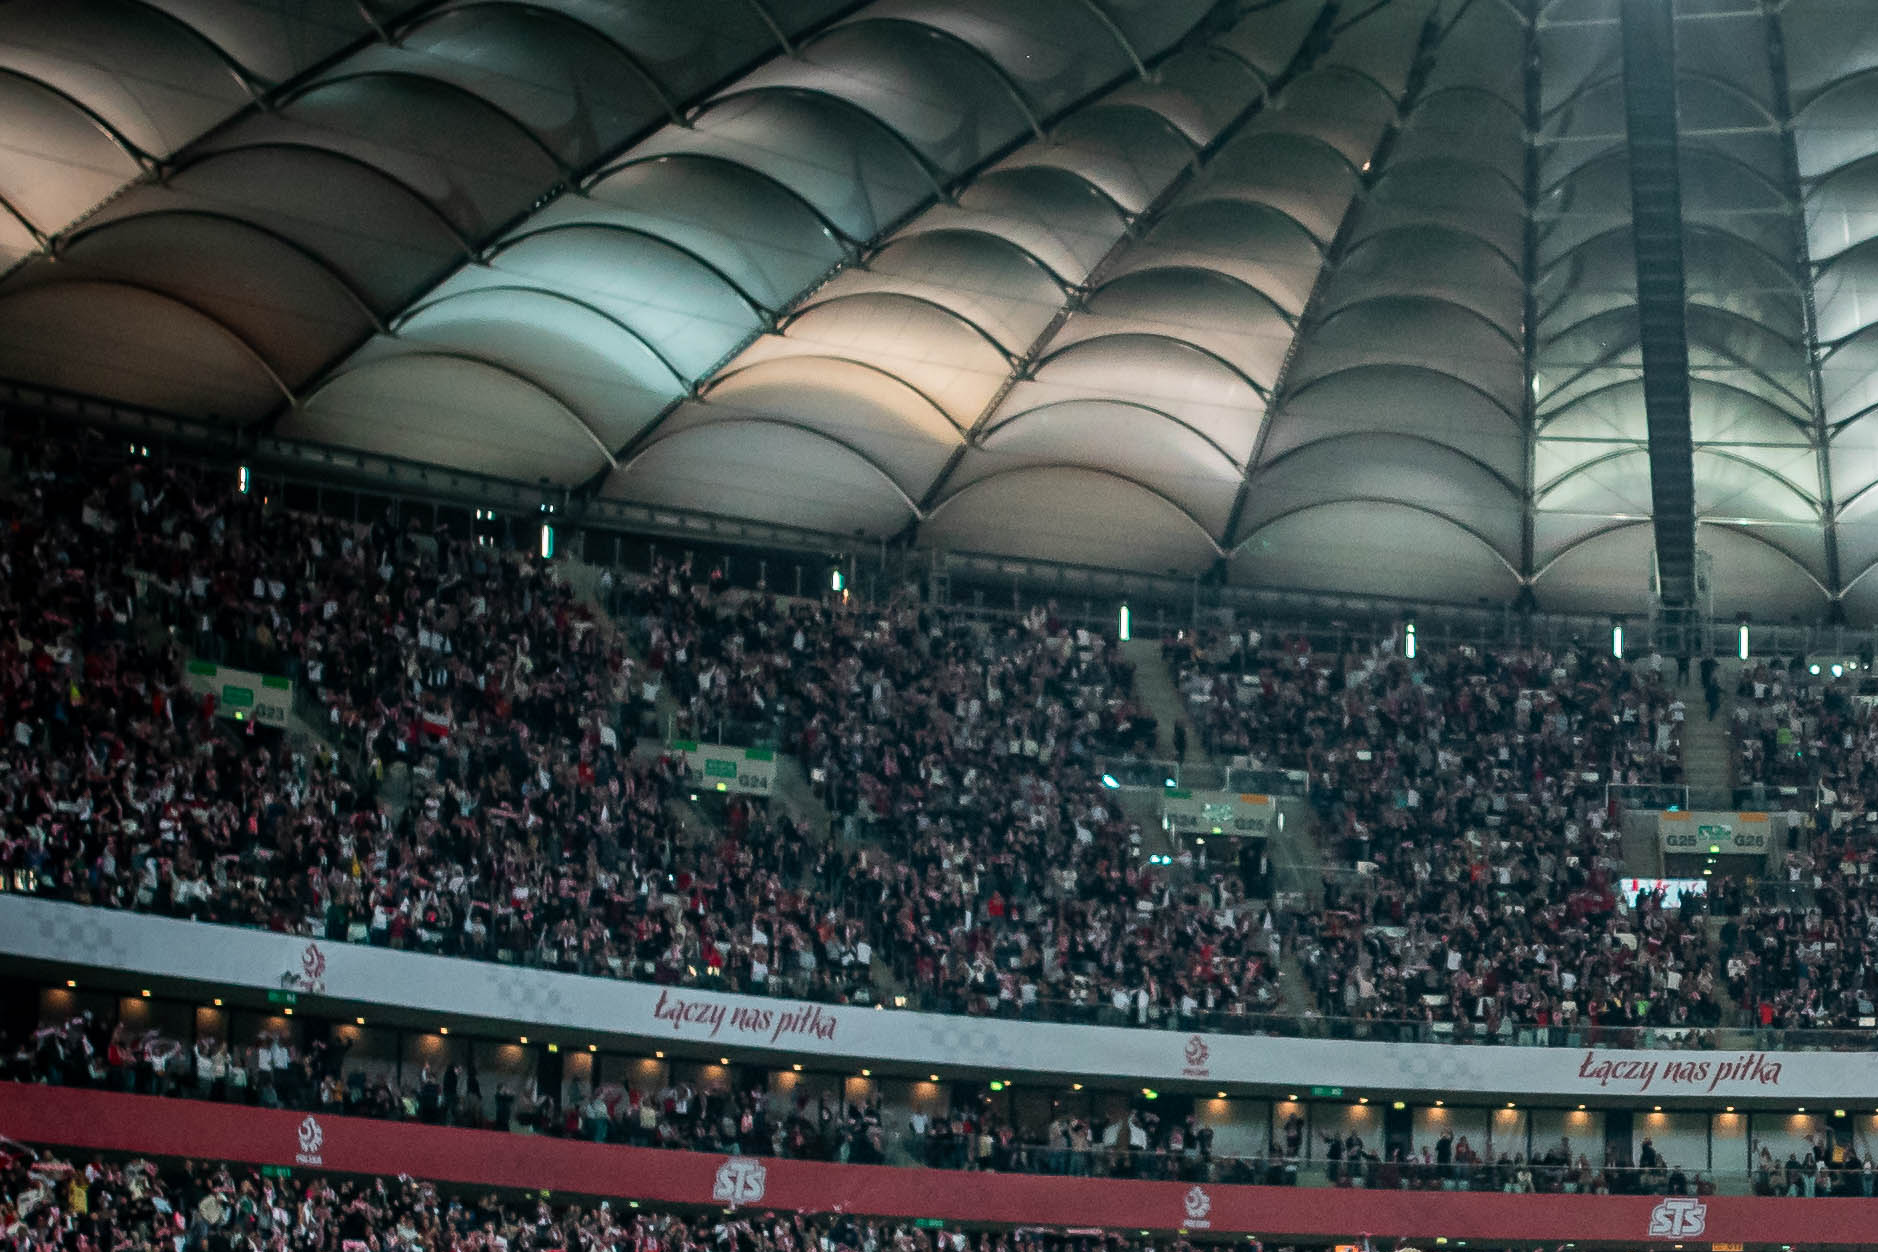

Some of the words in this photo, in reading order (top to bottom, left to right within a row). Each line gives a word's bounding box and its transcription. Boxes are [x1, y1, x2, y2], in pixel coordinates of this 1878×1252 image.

[1666, 834, 1697, 847] G25
[654, 989, 727, 1038] Łączy
[730, 1005, 774, 1033] nas
[771, 1004, 837, 1044] piłka
[1578, 1051, 1660, 1093] Łączy
[1662, 1060, 1711, 1085] nas
[1707, 1053, 1783, 1094] piłka
[714, 1158, 766, 1203] STS
[1649, 1198, 1707, 1238] STS
